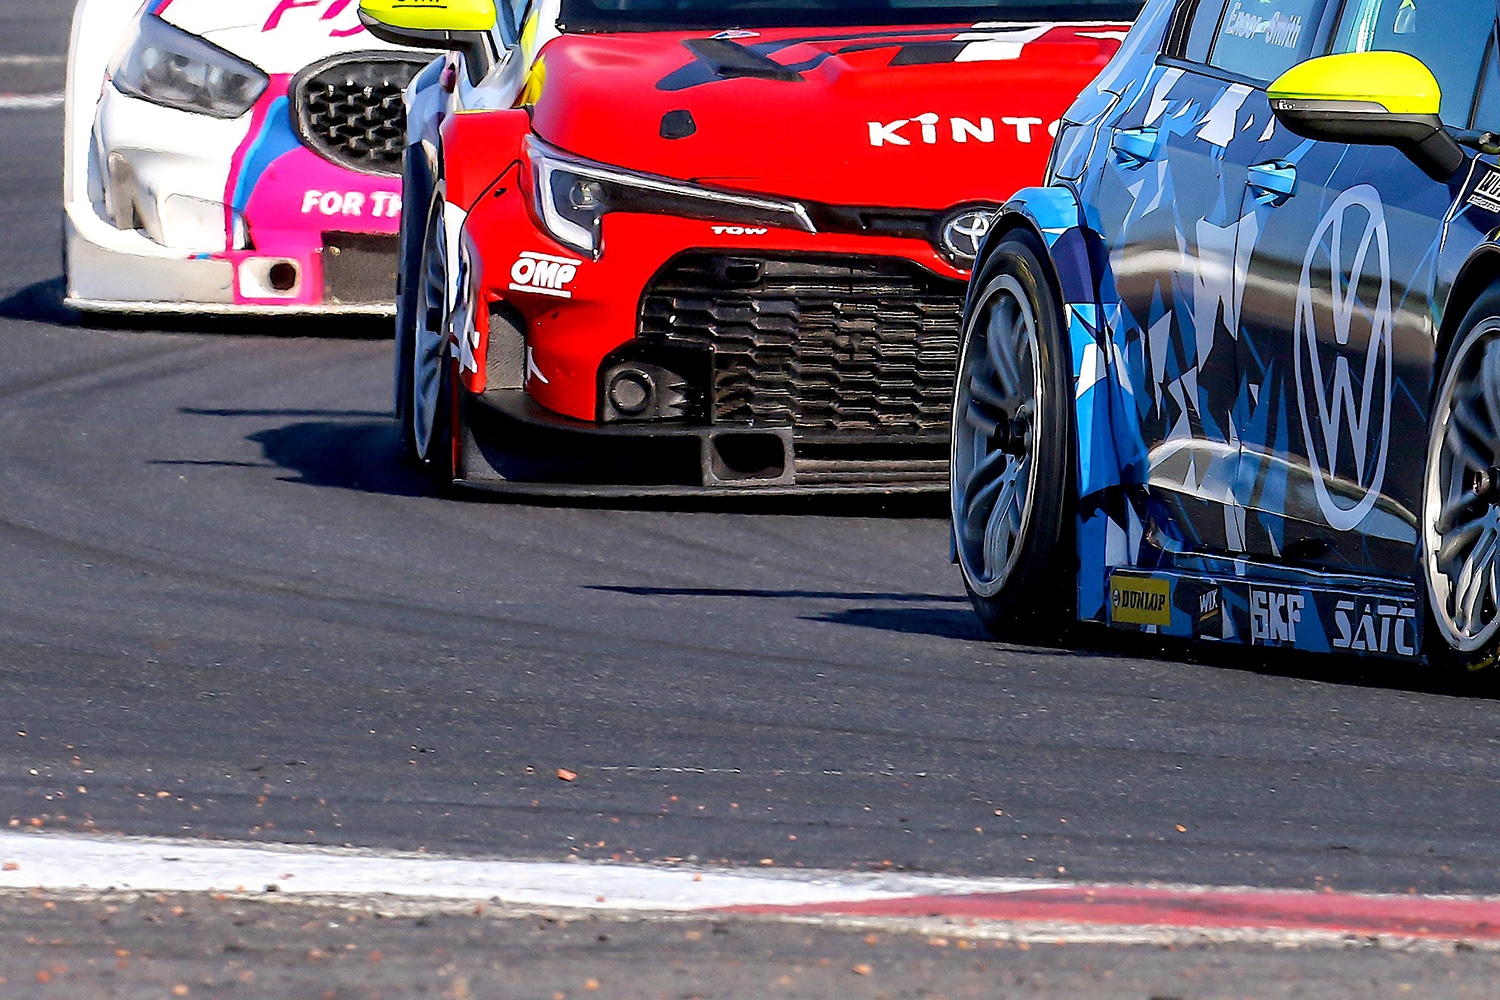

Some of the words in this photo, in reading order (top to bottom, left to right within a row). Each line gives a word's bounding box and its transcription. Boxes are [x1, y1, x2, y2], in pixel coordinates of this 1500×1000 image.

[301, 190, 365, 216] FOR
[711, 225, 768, 235] TOW
[510, 258, 577, 289] OMP
[1121, 590, 1166, 612] DUNLOP
[1200, 588, 1218, 614] WIX
[1251, 590, 1305, 642] SKF
[1333, 600, 1416, 656] SATC
